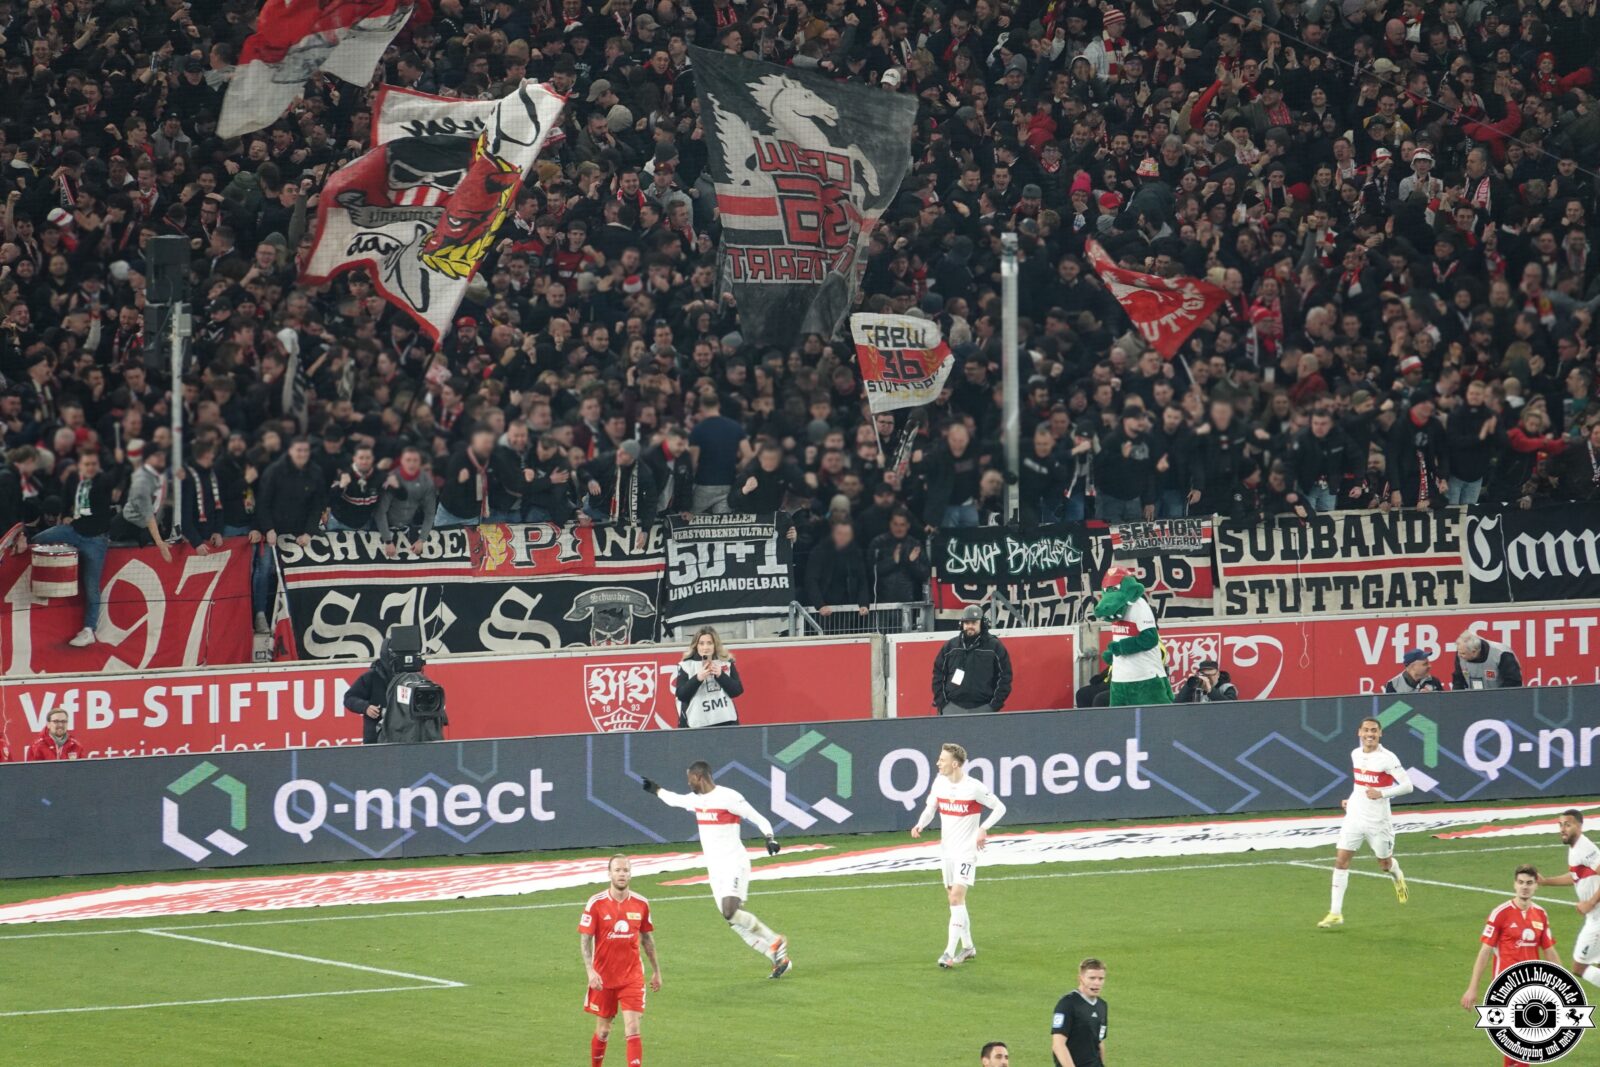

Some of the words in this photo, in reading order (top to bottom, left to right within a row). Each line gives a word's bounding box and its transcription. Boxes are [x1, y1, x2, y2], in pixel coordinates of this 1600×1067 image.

[721, 513, 757, 524] ALLEN
[1119, 519, 1201, 541] SEKTION
[673, 528, 740, 540] VERSTORBENEN
[742, 527, 774, 536] ULTRAS
[669, 576, 789, 601] UNVERHANDELBAR
[1225, 570, 1464, 616] STUTTGART
[878, 738, 1150, 811] Qnnect
[273, 768, 556, 844] Q-nnect
[960, 862, 972, 876] 27
